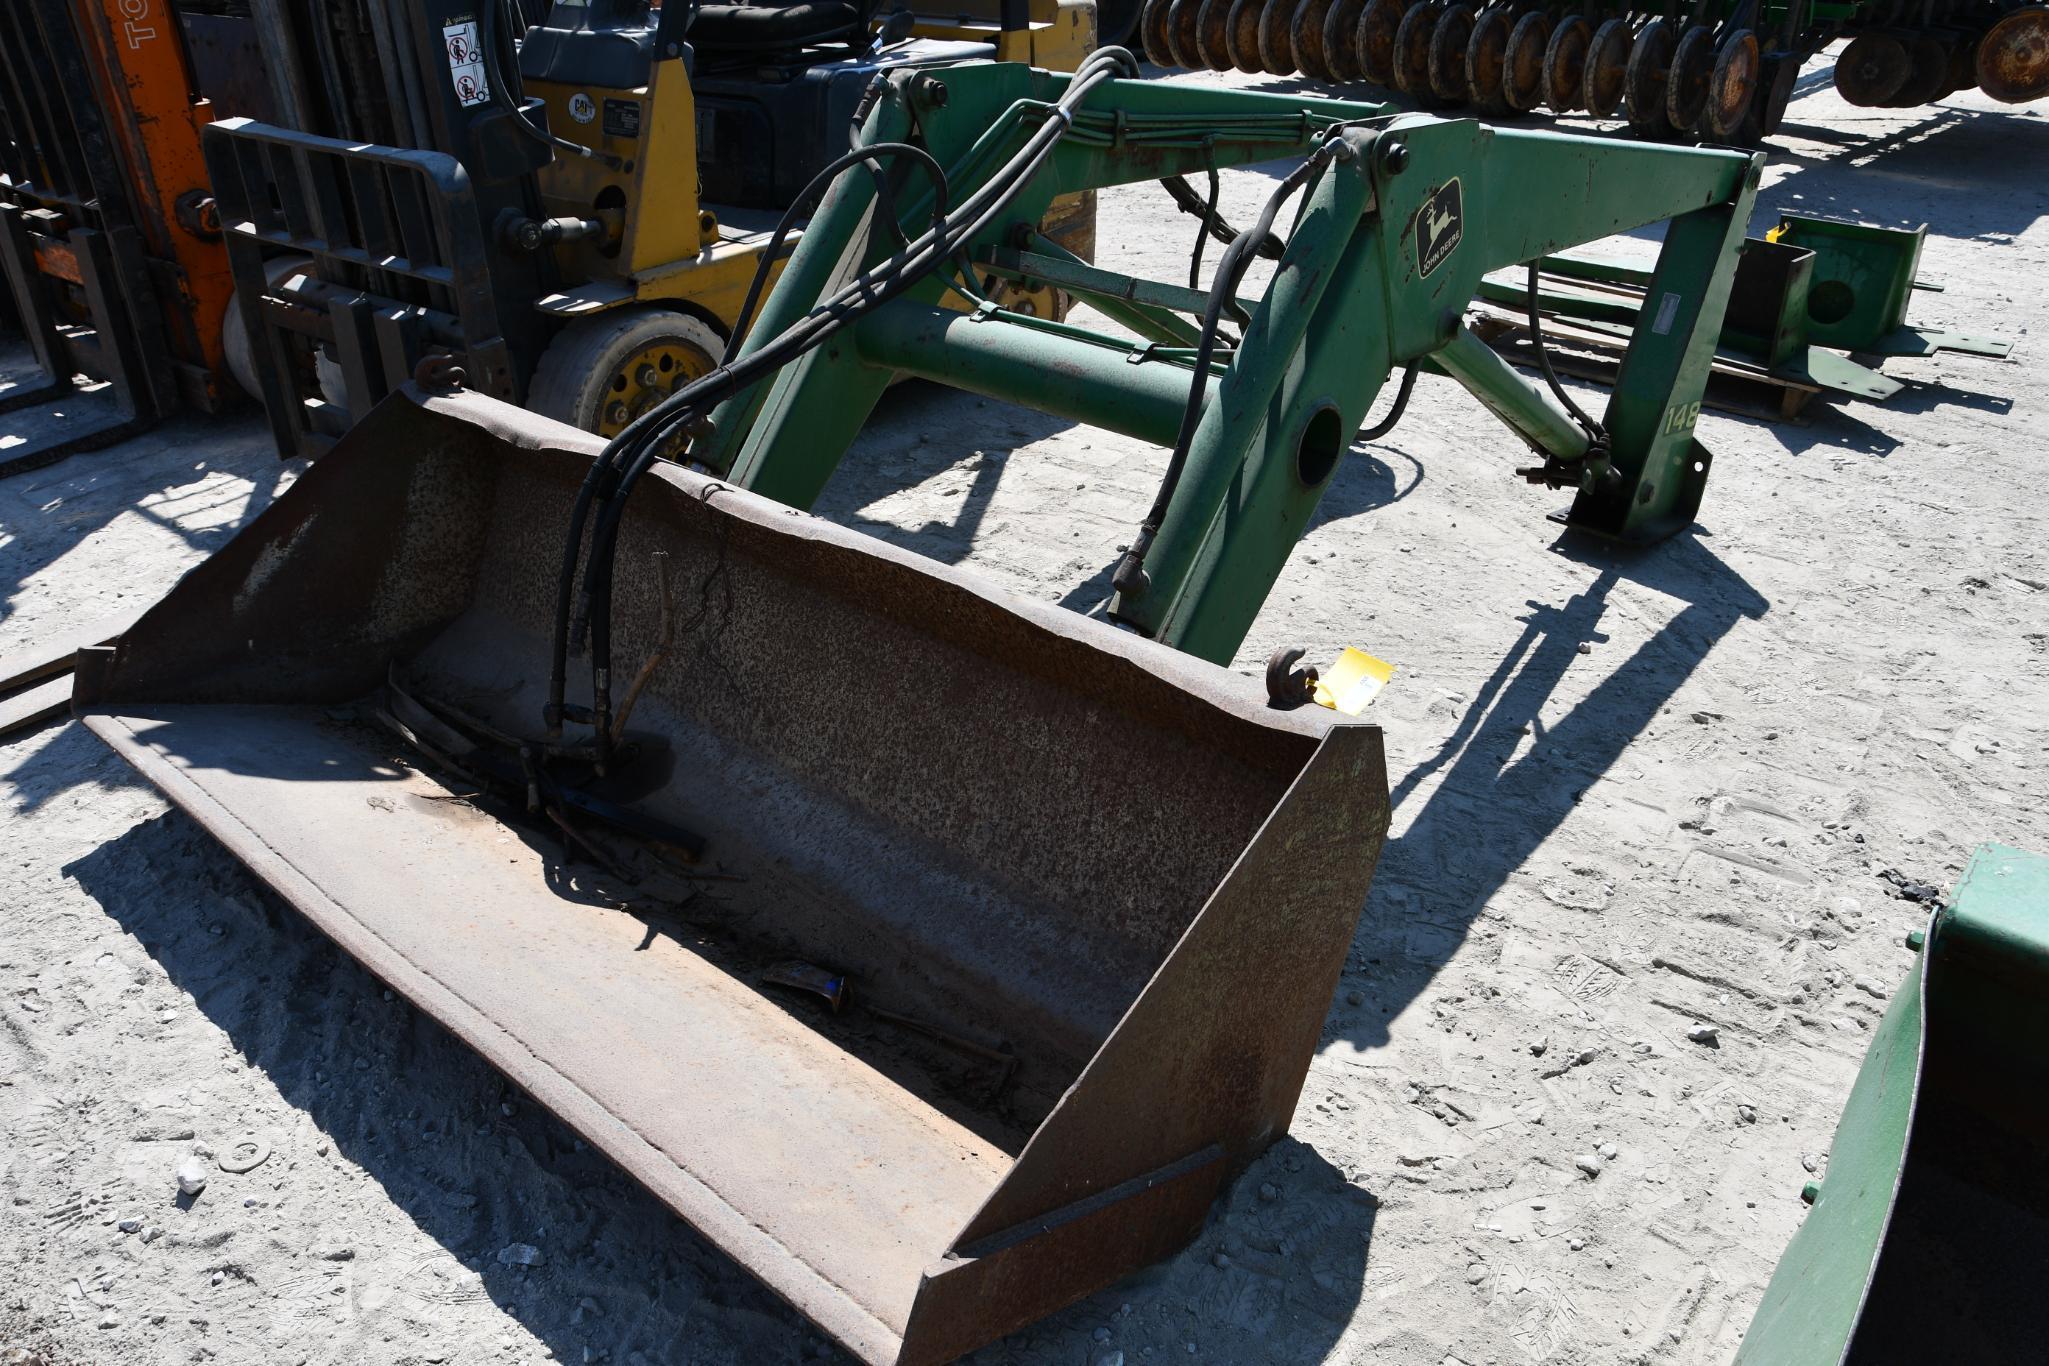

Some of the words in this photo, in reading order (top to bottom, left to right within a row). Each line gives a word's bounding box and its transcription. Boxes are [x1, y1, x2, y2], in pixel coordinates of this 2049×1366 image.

[1422, 250, 1440, 274] JOHN
[1440, 229, 1461, 254] DEERE
[1665, 401, 1701, 434] 148
